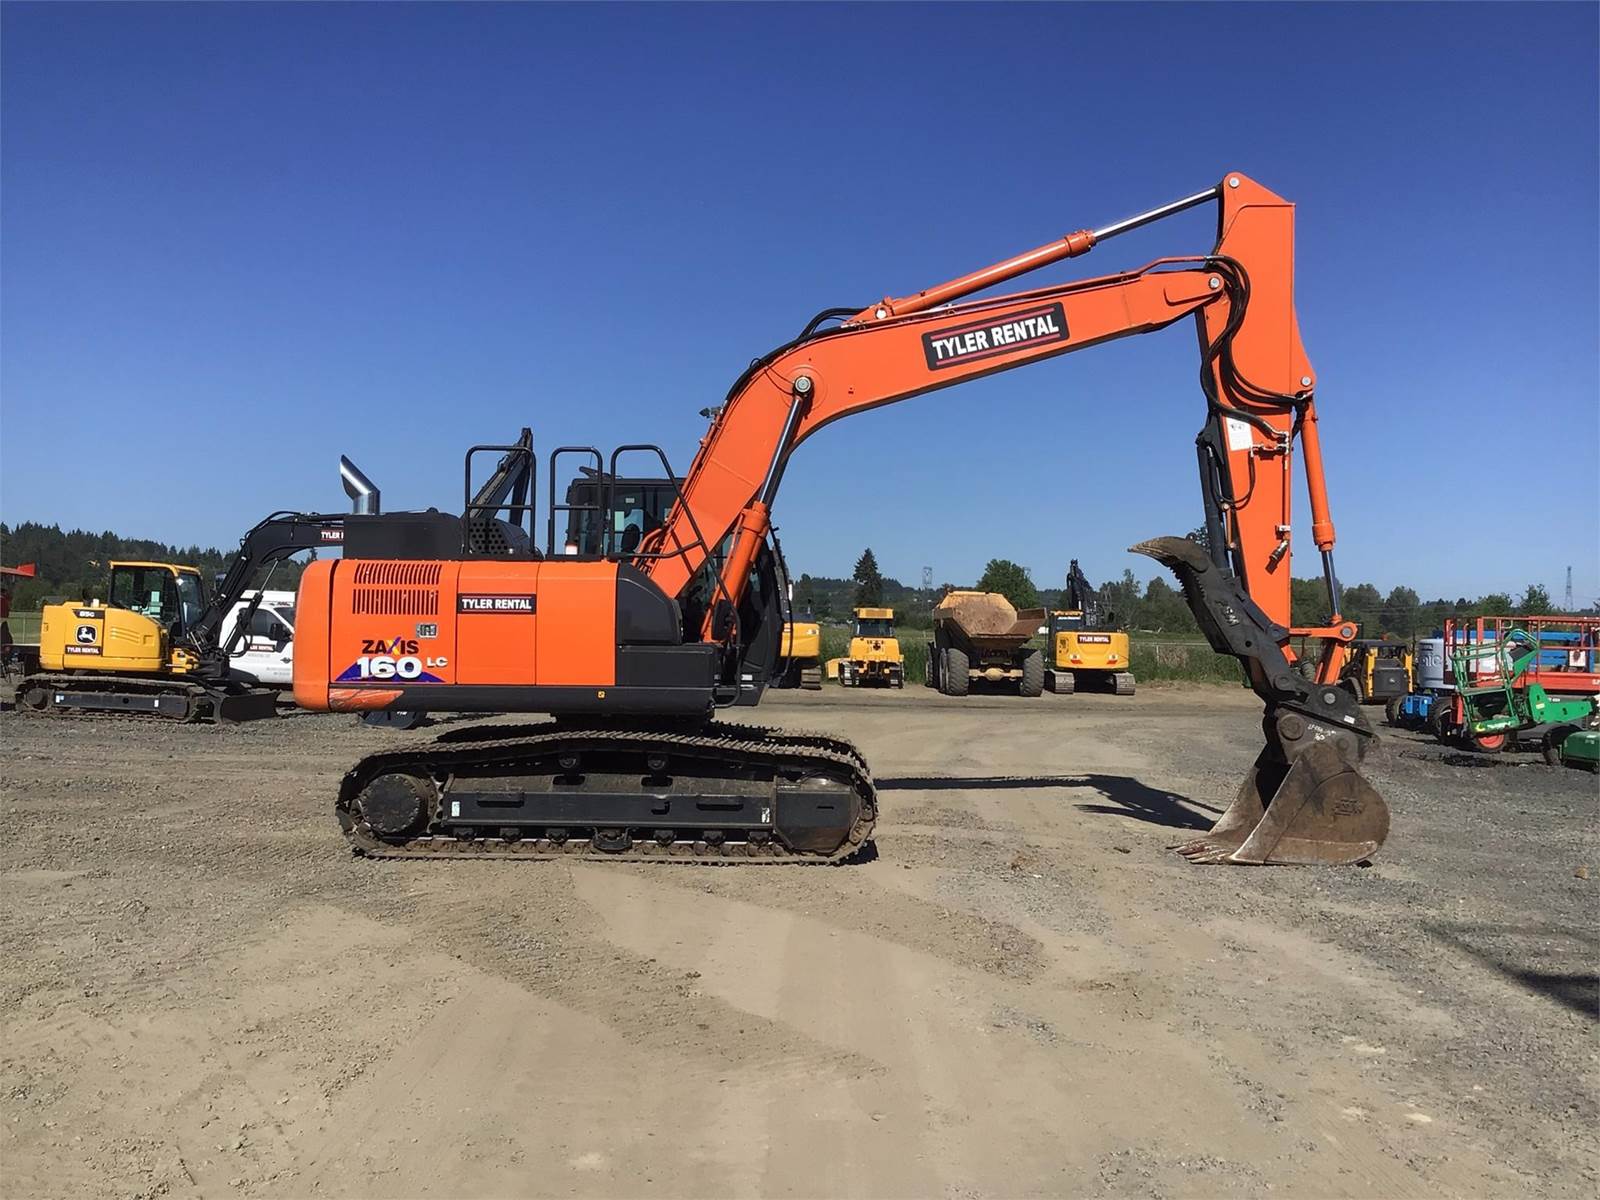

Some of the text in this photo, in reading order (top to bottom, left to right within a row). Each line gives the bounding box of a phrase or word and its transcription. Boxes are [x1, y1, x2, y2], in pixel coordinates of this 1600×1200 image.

[932, 314, 1060, 360] TYLER RENTAL
[320, 531, 340, 539] TYLER
[462, 598, 532, 609] TYLER RENTAL
[361, 636, 419, 656] ZAXIS
[356, 656, 448, 680] 160 LC
